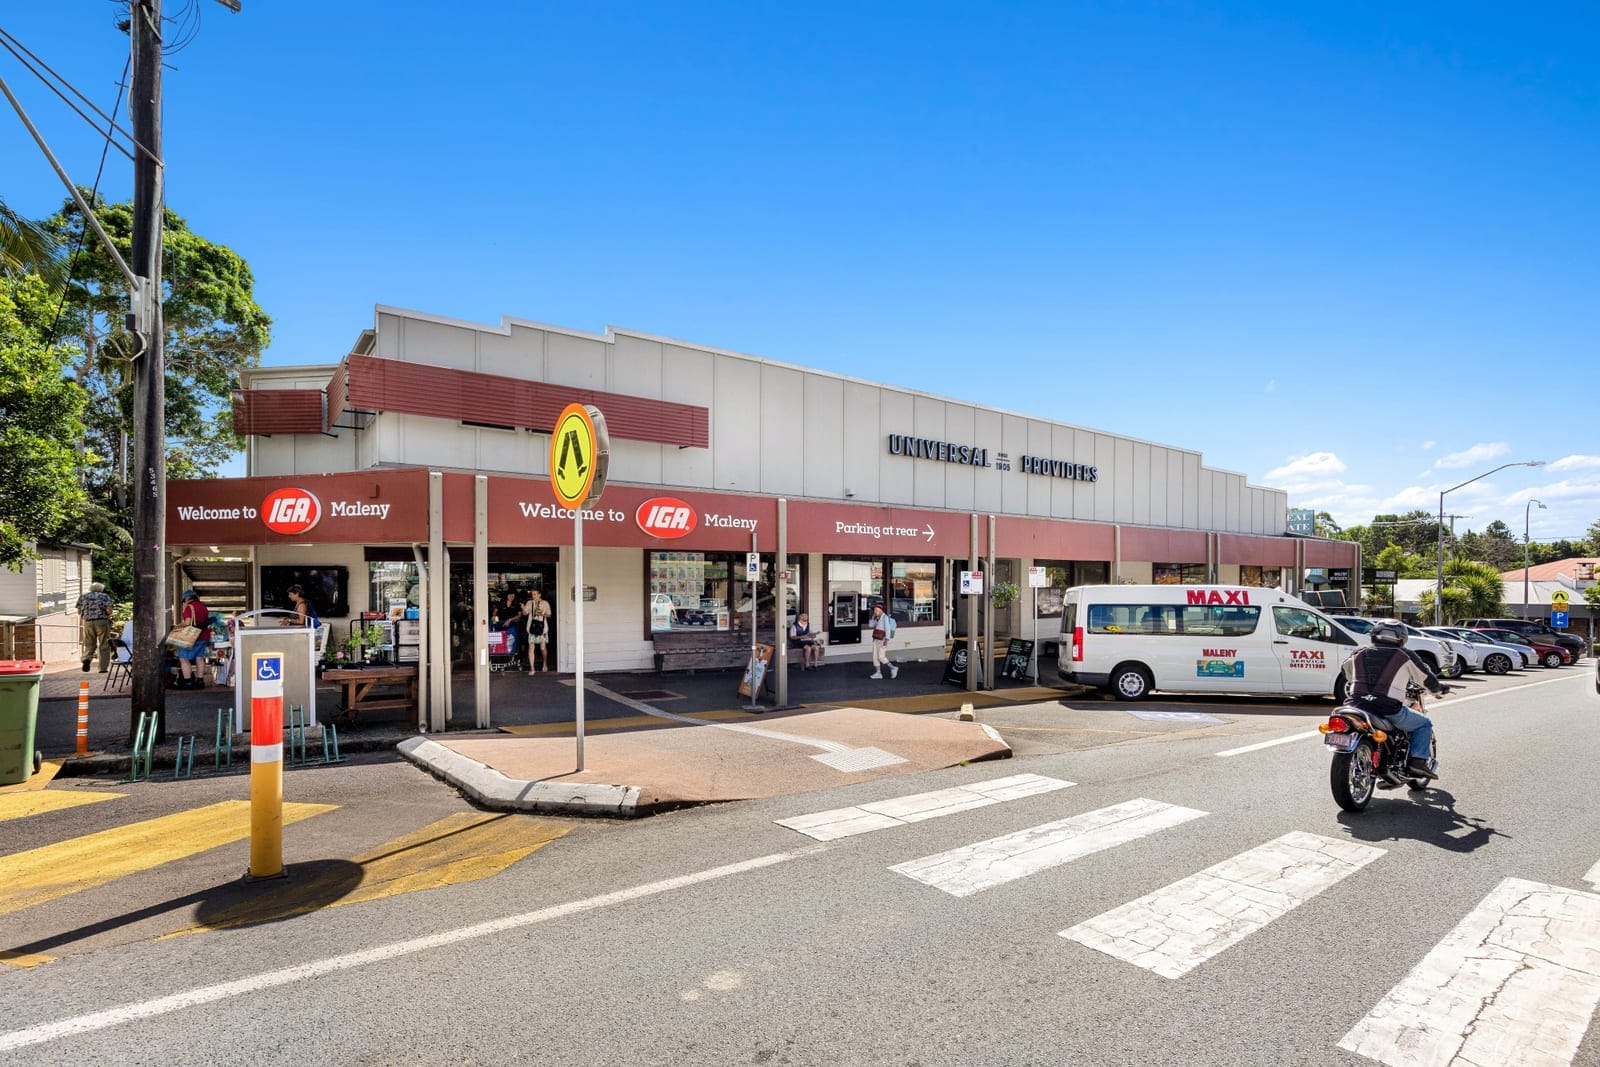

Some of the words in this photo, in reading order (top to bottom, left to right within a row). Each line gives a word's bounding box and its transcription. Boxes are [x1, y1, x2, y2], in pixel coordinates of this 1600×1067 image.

[889, 434, 991, 467] UNIVERSAL
[1021, 455, 1098, 482] PROVIDERS
[177, 506, 240, 520] Welcome
[242, 506, 257, 519] to
[269, 498, 310, 523] IGA
[331, 501, 390, 519] Maleny
[519, 502, 604, 521] Welcome
[608, 508, 625, 522] to
[645, 505, 690, 529] IGA
[704, 513, 758, 532] Maleny
[1287, 513, 1310, 522] EAL
[835, 521, 881, 539] Parking
[882, 525, 894, 536] at
[895, 526, 918, 537] rear
[1287, 523, 1310, 531] ATE
[749, 554, 757, 563] P
[1186, 589, 1250, 605] MAXI
[1556, 612, 1565, 620] P
[1202, 648, 1238, 658] MALENY
[1290, 650, 1325, 660] TAXI
